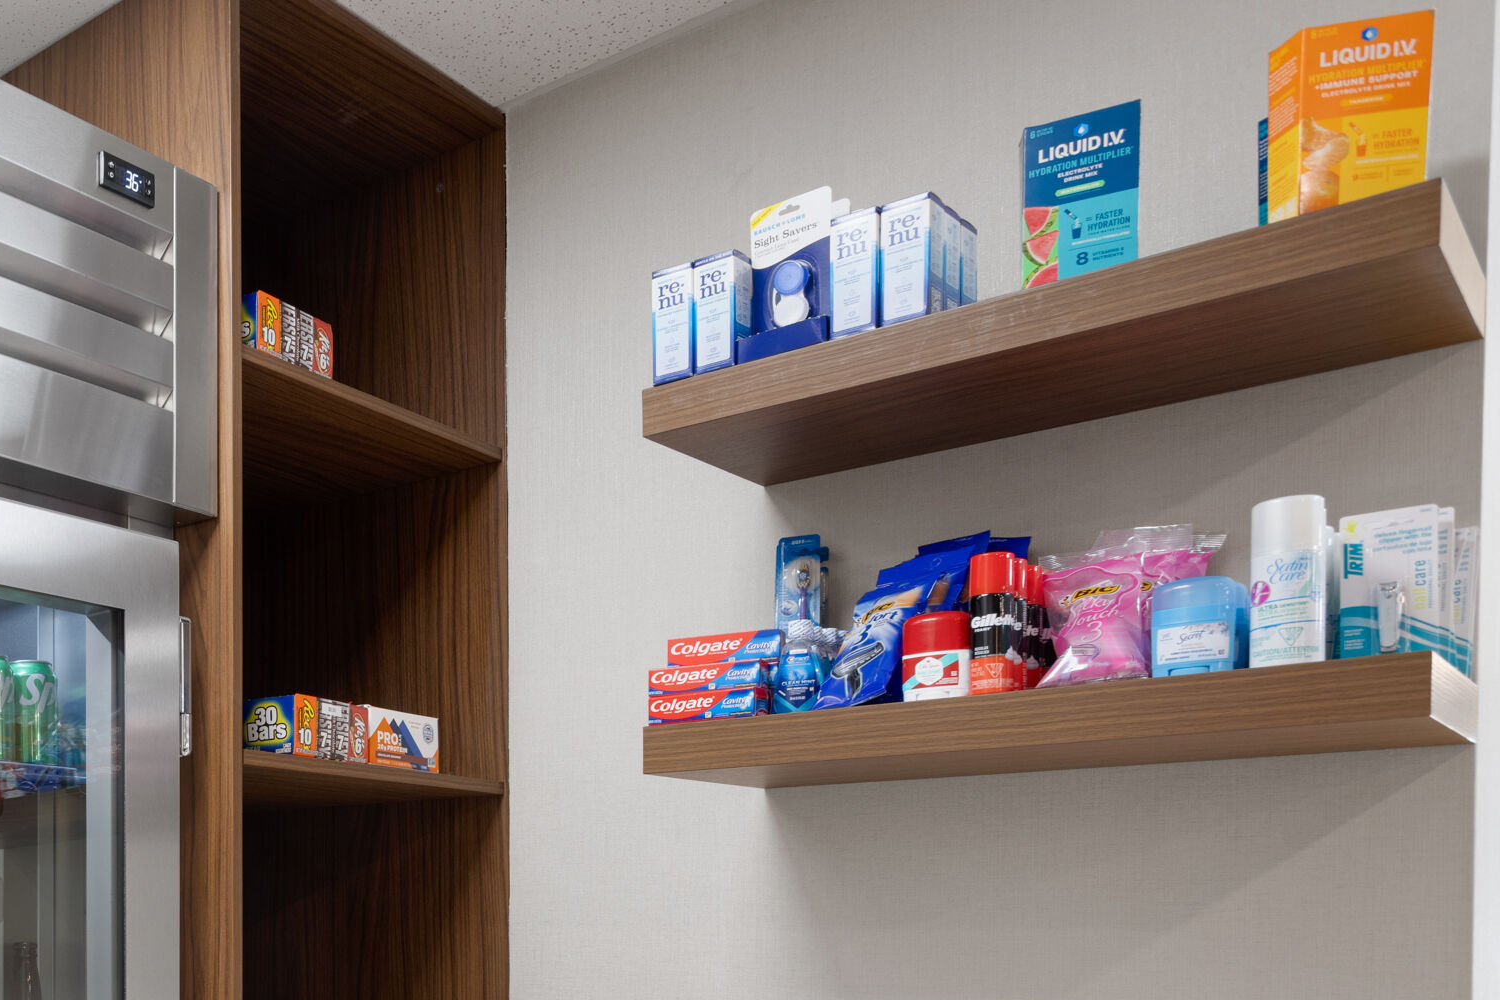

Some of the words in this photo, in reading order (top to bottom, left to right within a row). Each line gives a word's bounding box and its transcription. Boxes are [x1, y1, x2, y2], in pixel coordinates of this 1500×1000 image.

[1319, 42, 1391, 68] LIQUID
[1393, 38, 1417, 57] I.V.
[1308, 68, 1365, 84] HYDRATION
[1367, 61, 1424, 76] MULTIPLIER
[1369, 70, 1419, 84] SUPPORT
[1037, 135, 1101, 164] LIQUID
[1103, 128, 1125, 146] I.V.
[1028, 159, 1077, 179] HYDRATION
[1079, 147, 1131, 166] MULTIPLIER
[1057, 162, 1103, 179] ELECTROLYTE
[125, 170, 139, 192] 36
[1063, 173, 1084, 183] DRINK
[1085, 170, 1098, 180] MIX
[1095, 208, 1123, 222] FASTER
[1087, 216, 1131, 232] HYDRATION
[754, 235, 780, 249] Sight
[782, 222, 818, 239] Savers
[888, 227, 920, 247] nu
[837, 240, 867, 260] nu
[1076, 251, 1089, 266] 8
[700, 281, 726, 299] nu
[658, 293, 684, 310] nu
[1267, 559, 1308, 574] Satin
[1343, 543, 1363, 579] TRIM
[1269, 571, 1306, 584] Care
[1415, 560, 1426, 586] care
[1074, 585, 1116, 599] BIC
[1081, 621, 1102, 642] 3
[670, 639, 741, 656] Colgate
[745, 641, 772, 650] Cavity
[651, 668, 718, 685] Colgate
[727, 668, 751, 677] Cavity
[650, 696, 713, 714] Colgate
[722, 696, 745, 705] Cavity
[255, 706, 278, 726] 30
[247, 723, 287, 742] Bars
